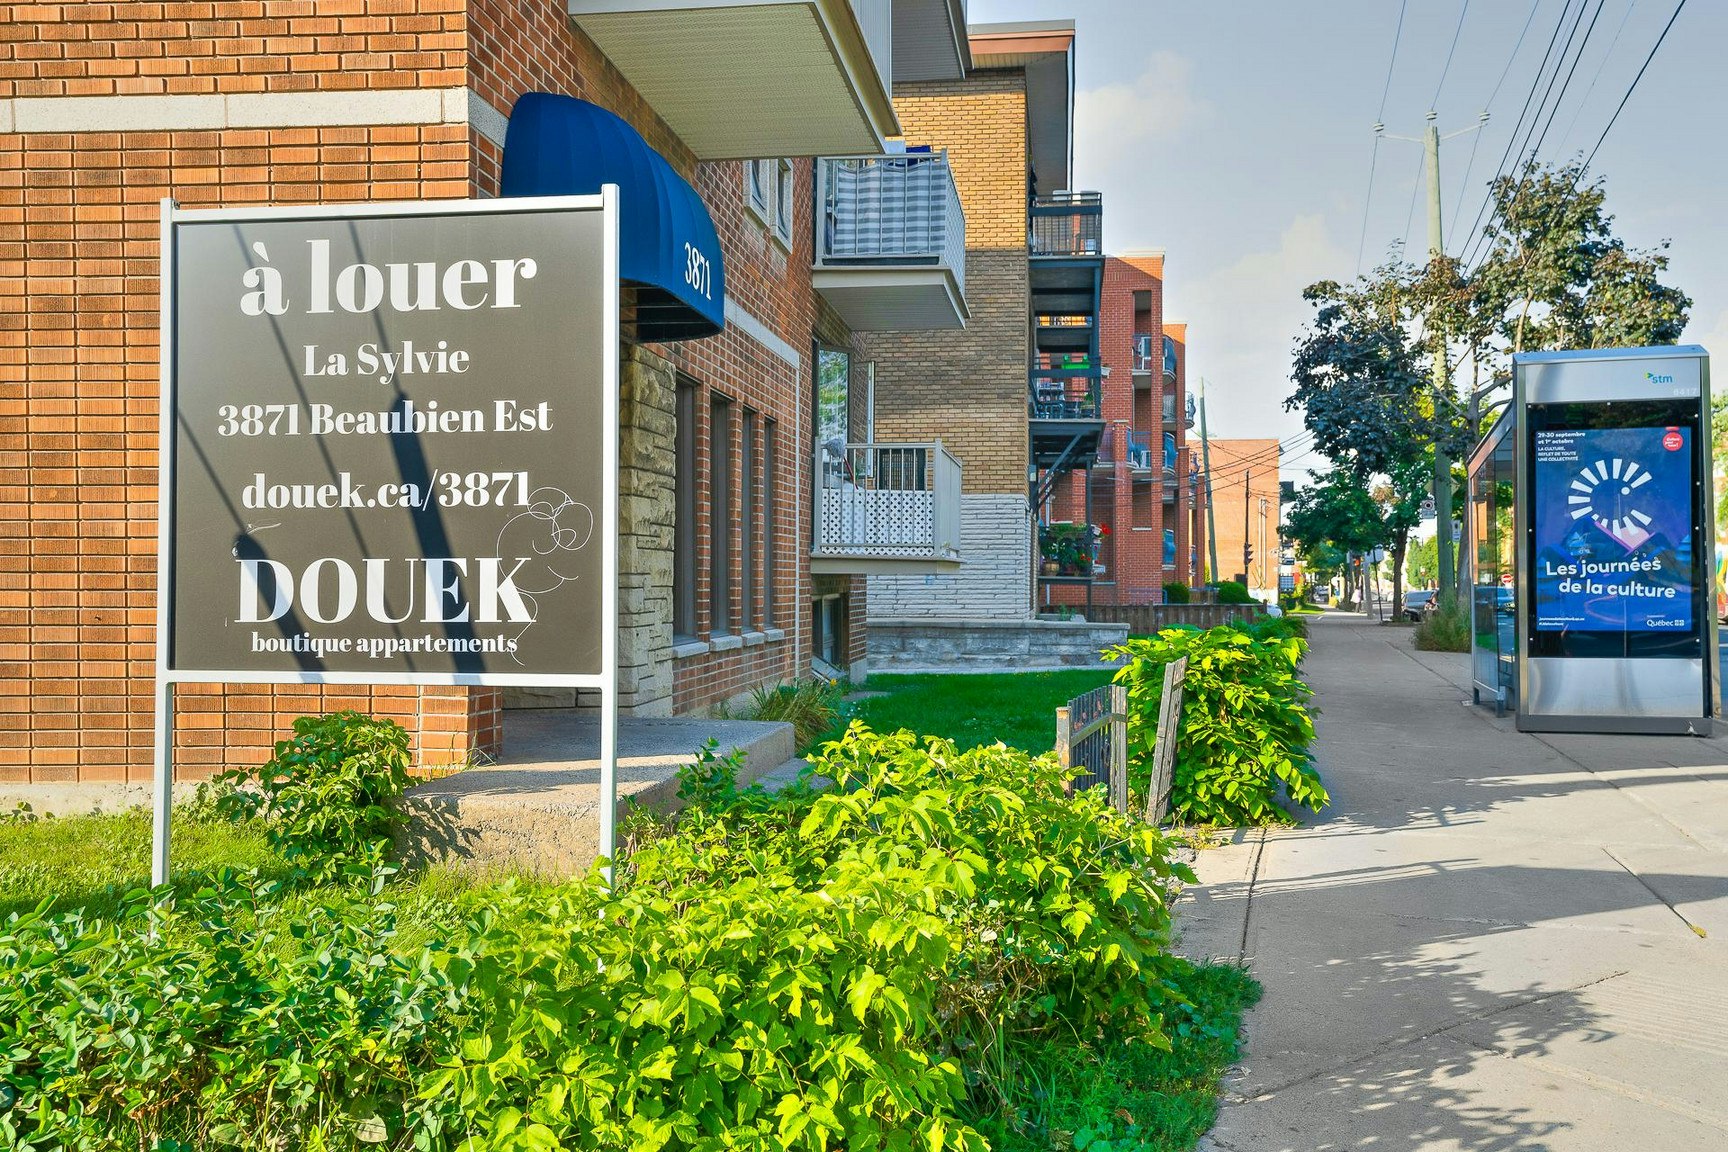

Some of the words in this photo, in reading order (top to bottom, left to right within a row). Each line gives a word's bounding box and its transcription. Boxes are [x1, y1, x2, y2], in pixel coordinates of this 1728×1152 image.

[239, 241, 289, 317] à
[306, 239, 537, 315] louer
[685, 242, 711, 300] 3871
[303, 345, 349, 376] La
[357, 340, 470, 385] Sylvie
[1652, 375, 1673, 384] stm
[218, 404, 300, 436] 3871
[309, 401, 485, 434] Beaubien
[494, 400, 553, 432] Est
[242, 468, 531, 511] douek.ca/3871
[1546, 561, 1577, 576] Les
[1580, 557, 1662, 578] journées
[234, 556, 537, 624] DOUEK
[1558, 578, 1582, 593] de
[1586, 579, 1603, 594] la
[1607, 581, 1677, 598] culture
[1646, 619, 1674, 627] Québec
[251, 631, 352, 658] boutique
[357, 634, 518, 661] appartements
